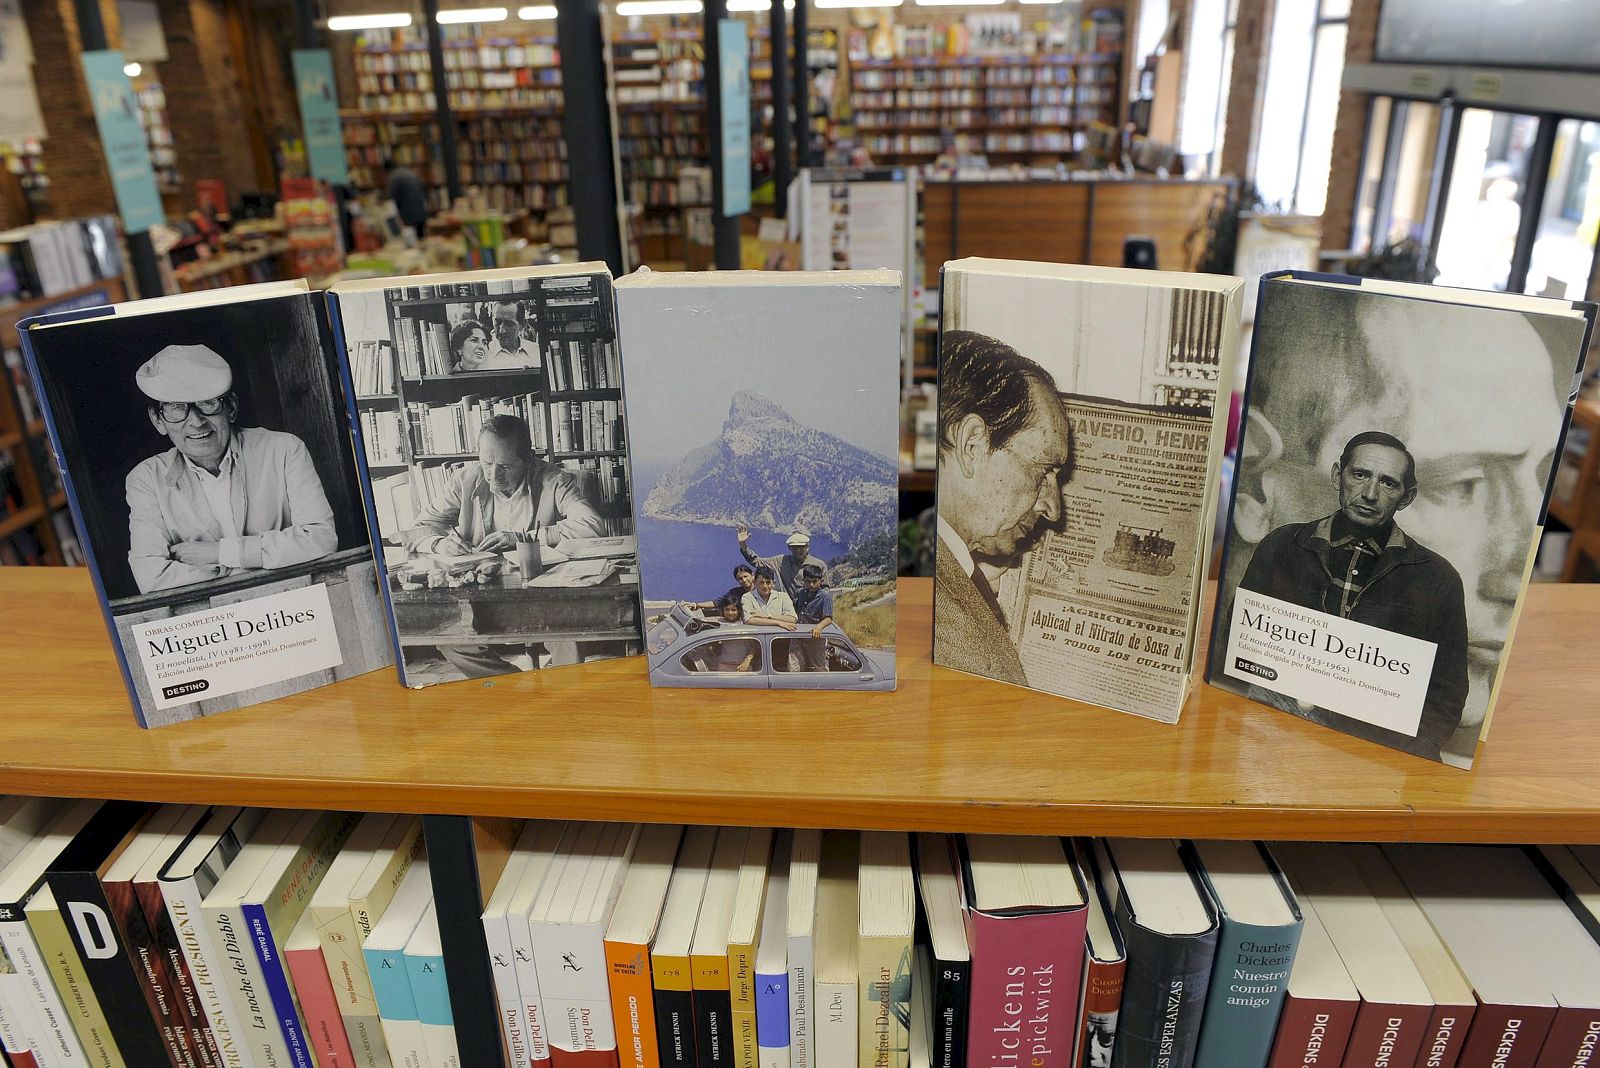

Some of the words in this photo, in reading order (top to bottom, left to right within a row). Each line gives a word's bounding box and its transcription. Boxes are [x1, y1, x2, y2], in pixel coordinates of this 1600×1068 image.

[1155, 428, 1209, 452] HENR
[144, 624, 174, 638] OBRAS
[174, 613, 225, 634] COMPLETAS
[226, 611, 236, 619] IV
[1244, 598, 1272, 612] OBRAS
[1271, 604, 1322, 627] COMPLETAS
[1322, 621, 1330, 629] II
[147, 624, 230, 658] Miguel
[234, 608, 316, 639] Delibes
[1074, 620, 1085, 637] el
[1088, 622, 1124, 646] Nitrato
[1128, 633, 1141, 650] de
[1144, 636, 1168, 657] Sosa
[1174, 642, 1184, 660] d
[1240, 608, 1316, 648] Miguel
[1324, 633, 1412, 676] Delibes
[155, 662, 166, 672] El
[166, 655, 207, 670] novelista,
[208, 649, 220, 660] IV
[220, 638, 272, 658] (1981-1998)
[157, 668, 186, 680] Edición
[186, 662, 214, 674] dirigida
[214, 658, 228, 668] por
[228, 652, 255, 664] Ramón
[254, 646, 279, 658] García
[279, 636, 318, 652] Domínguez
[1041, 632, 1057, 642] EN
[1064, 639, 1101, 654] TODOS
[1107, 650, 1130, 661] LOS
[1239, 632, 1250, 642] El
[1250, 636, 1286, 655] novelista,
[1288, 648, 1297, 657] II
[1298, 652, 1351, 676] (1953-1962)
[1237, 660, 1276, 680] DESTINO
[1238, 642, 1263, 656] Edición
[1263, 650, 1291, 664] dirigida
[1290, 657, 1305, 670] por
[1304, 662, 1332, 678] Ramón
[1332, 672, 1357, 686] García
[1358, 680, 1402, 700] Domínguez
[166, 680, 207, 698] DESTINO
[67, 902, 118, 959] D
[216, 914, 240, 955] Diablo
[252, 918, 265, 936] RENÉ
[331, 934, 342, 942] 13
[170, 900, 212, 986] PRESIDENTE
[258, 935, 272, 962] DAUMAL
[1240, 941, 1291, 953] Charles
[228, 955, 248, 976] del
[736, 953, 749, 979] Deprá
[1236, 954, 1291, 966] Dickens
[138, 946, 158, 986] Alessandro
[152, 985, 170, 1016] D'Avenia
[168, 948, 187, 986] Alessandro
[182, 986, 200, 1017] D'Avenia
[944, 970, 960, 982] 85
[1233, 970, 1288, 981] Nuestro
[239, 978, 261, 1014] noche
[738, 981, 750, 1002] Jorge
[794, 967, 806, 1018] Desalmand
[876, 966, 891, 1026] Dezcallar
[1230, 982, 1278, 994] común
[527, 1004, 537, 1022] Don
[830, 992, 842, 1010] Devi
[1227, 996, 1270, 1008] amigo
[44, 1007, 58, 1028] Cusset
[252, 1017, 266, 1030] La
[284, 1019, 293, 1029] EL
[506, 1010, 516, 1028] Don
[580, 1008, 590, 1026] Don
[628, 996, 640, 1036] PERDIDO
[672, 1012, 680, 1035] DENNIS
[710, 1011, 718, 1034] DENNIS
[796, 1017, 806, 1037] Paul
[944, 1007, 954, 1026] calle
[1160, 980, 1184, 1059] ESPERANZAS
[174, 1026, 190, 1050] blanca
[288, 1027, 300, 1047] MONTE
[531, 1024, 544, 1054] DeLillo
[566, 1007, 582, 1050] Submundo
[742, 1020, 752, 1040] VENIR
[1304, 1014, 1330, 1064] DICKENS
[170, 1042, 182, 1063] como
[198, 1042, 210, 1064] como
[510, 1030, 525, 1059] DeLillo
[633, 1036, 643, 1063] AMOR
[674, 1036, 682, 1060] PATRICK
[712, 1036, 720, 1060] PATRICK
[744, 1044, 752, 1060] POR
[875, 1030, 890, 1068] Rafael
[944, 1042, 952, 1052] en
[1374, 1018, 1402, 1068] DICKENS
[1427, 1018, 1456, 1067] DICKENS
[1491, 1020, 1522, 1068] DICKENS
